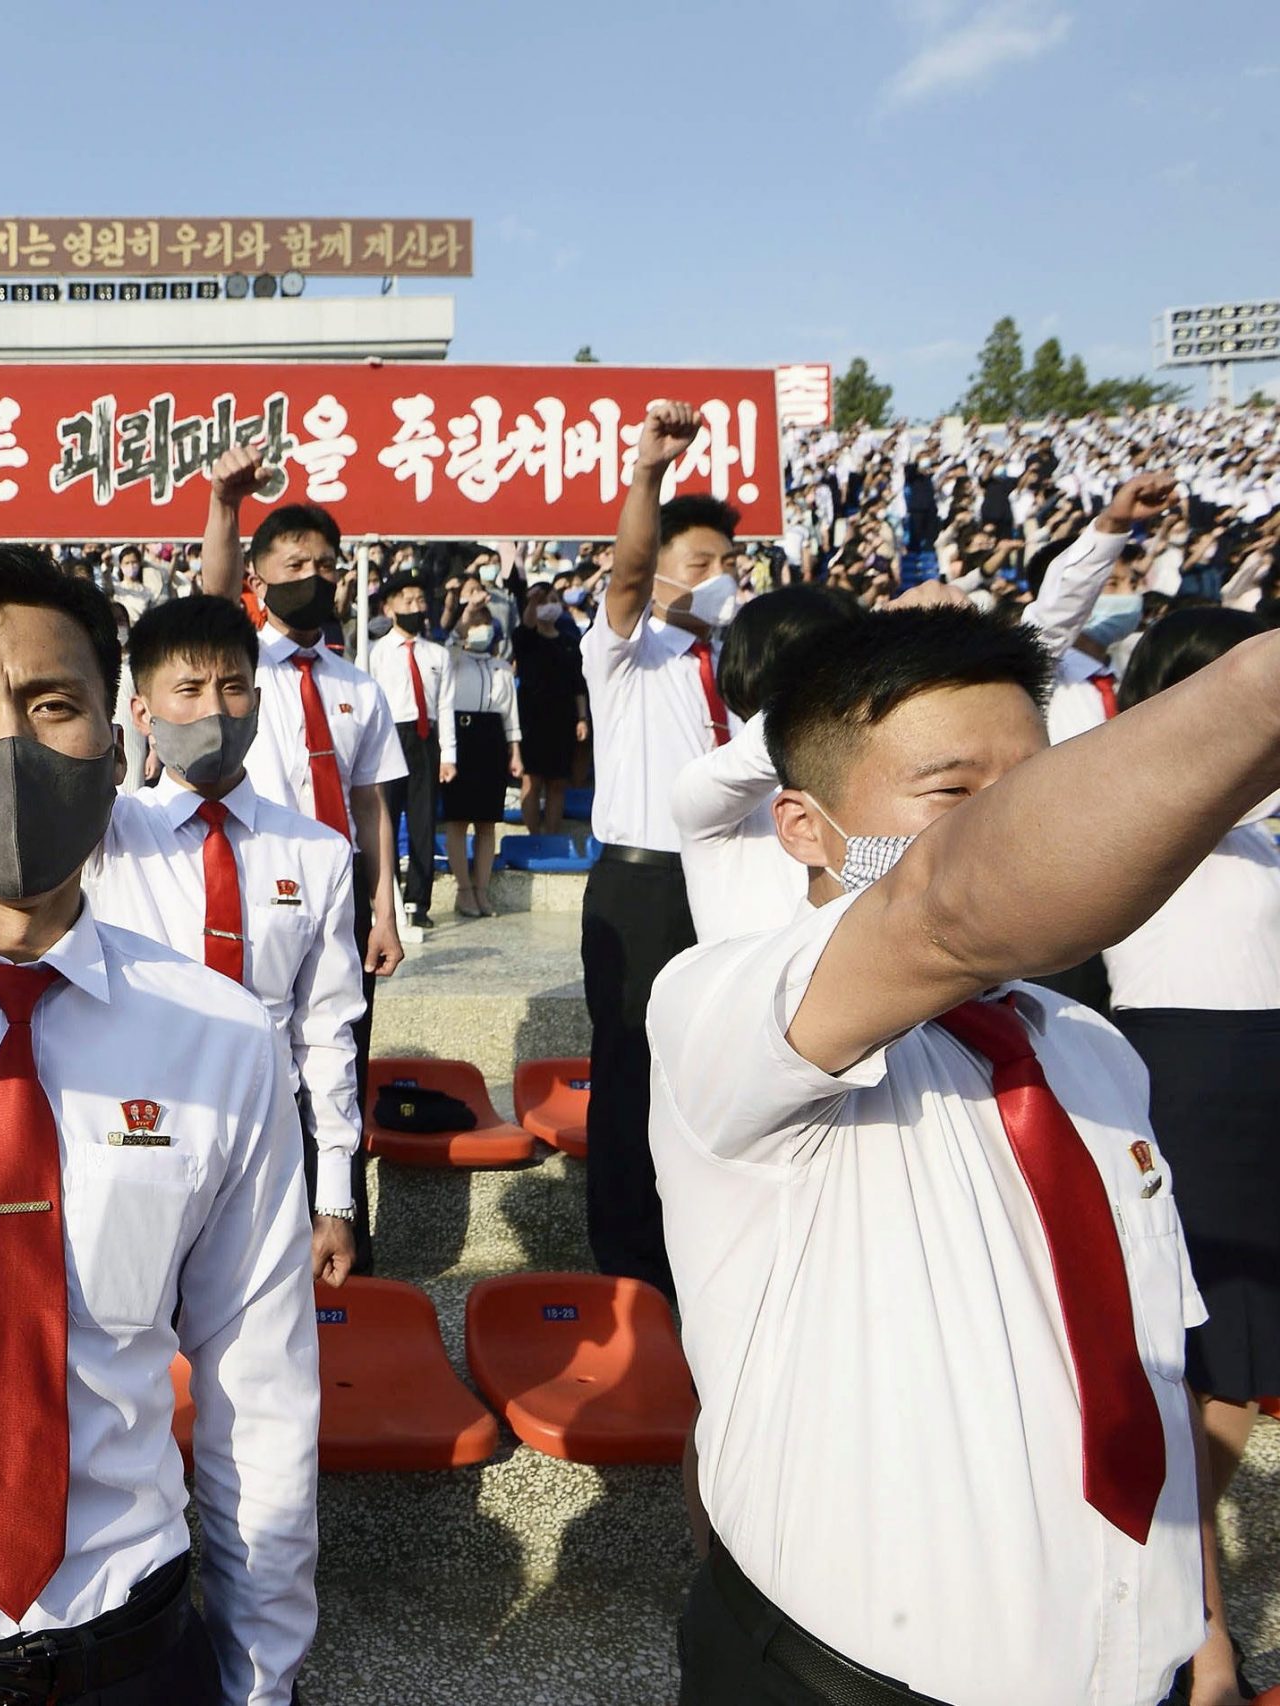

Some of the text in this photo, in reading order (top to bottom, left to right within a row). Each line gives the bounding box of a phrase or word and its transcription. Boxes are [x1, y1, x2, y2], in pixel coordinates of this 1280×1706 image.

[63, 222, 159, 267] 영원히
[167, 222, 270, 267] 우리와
[281, 222, 352, 267] 함께
[363, 222, 462, 267] 계신다
